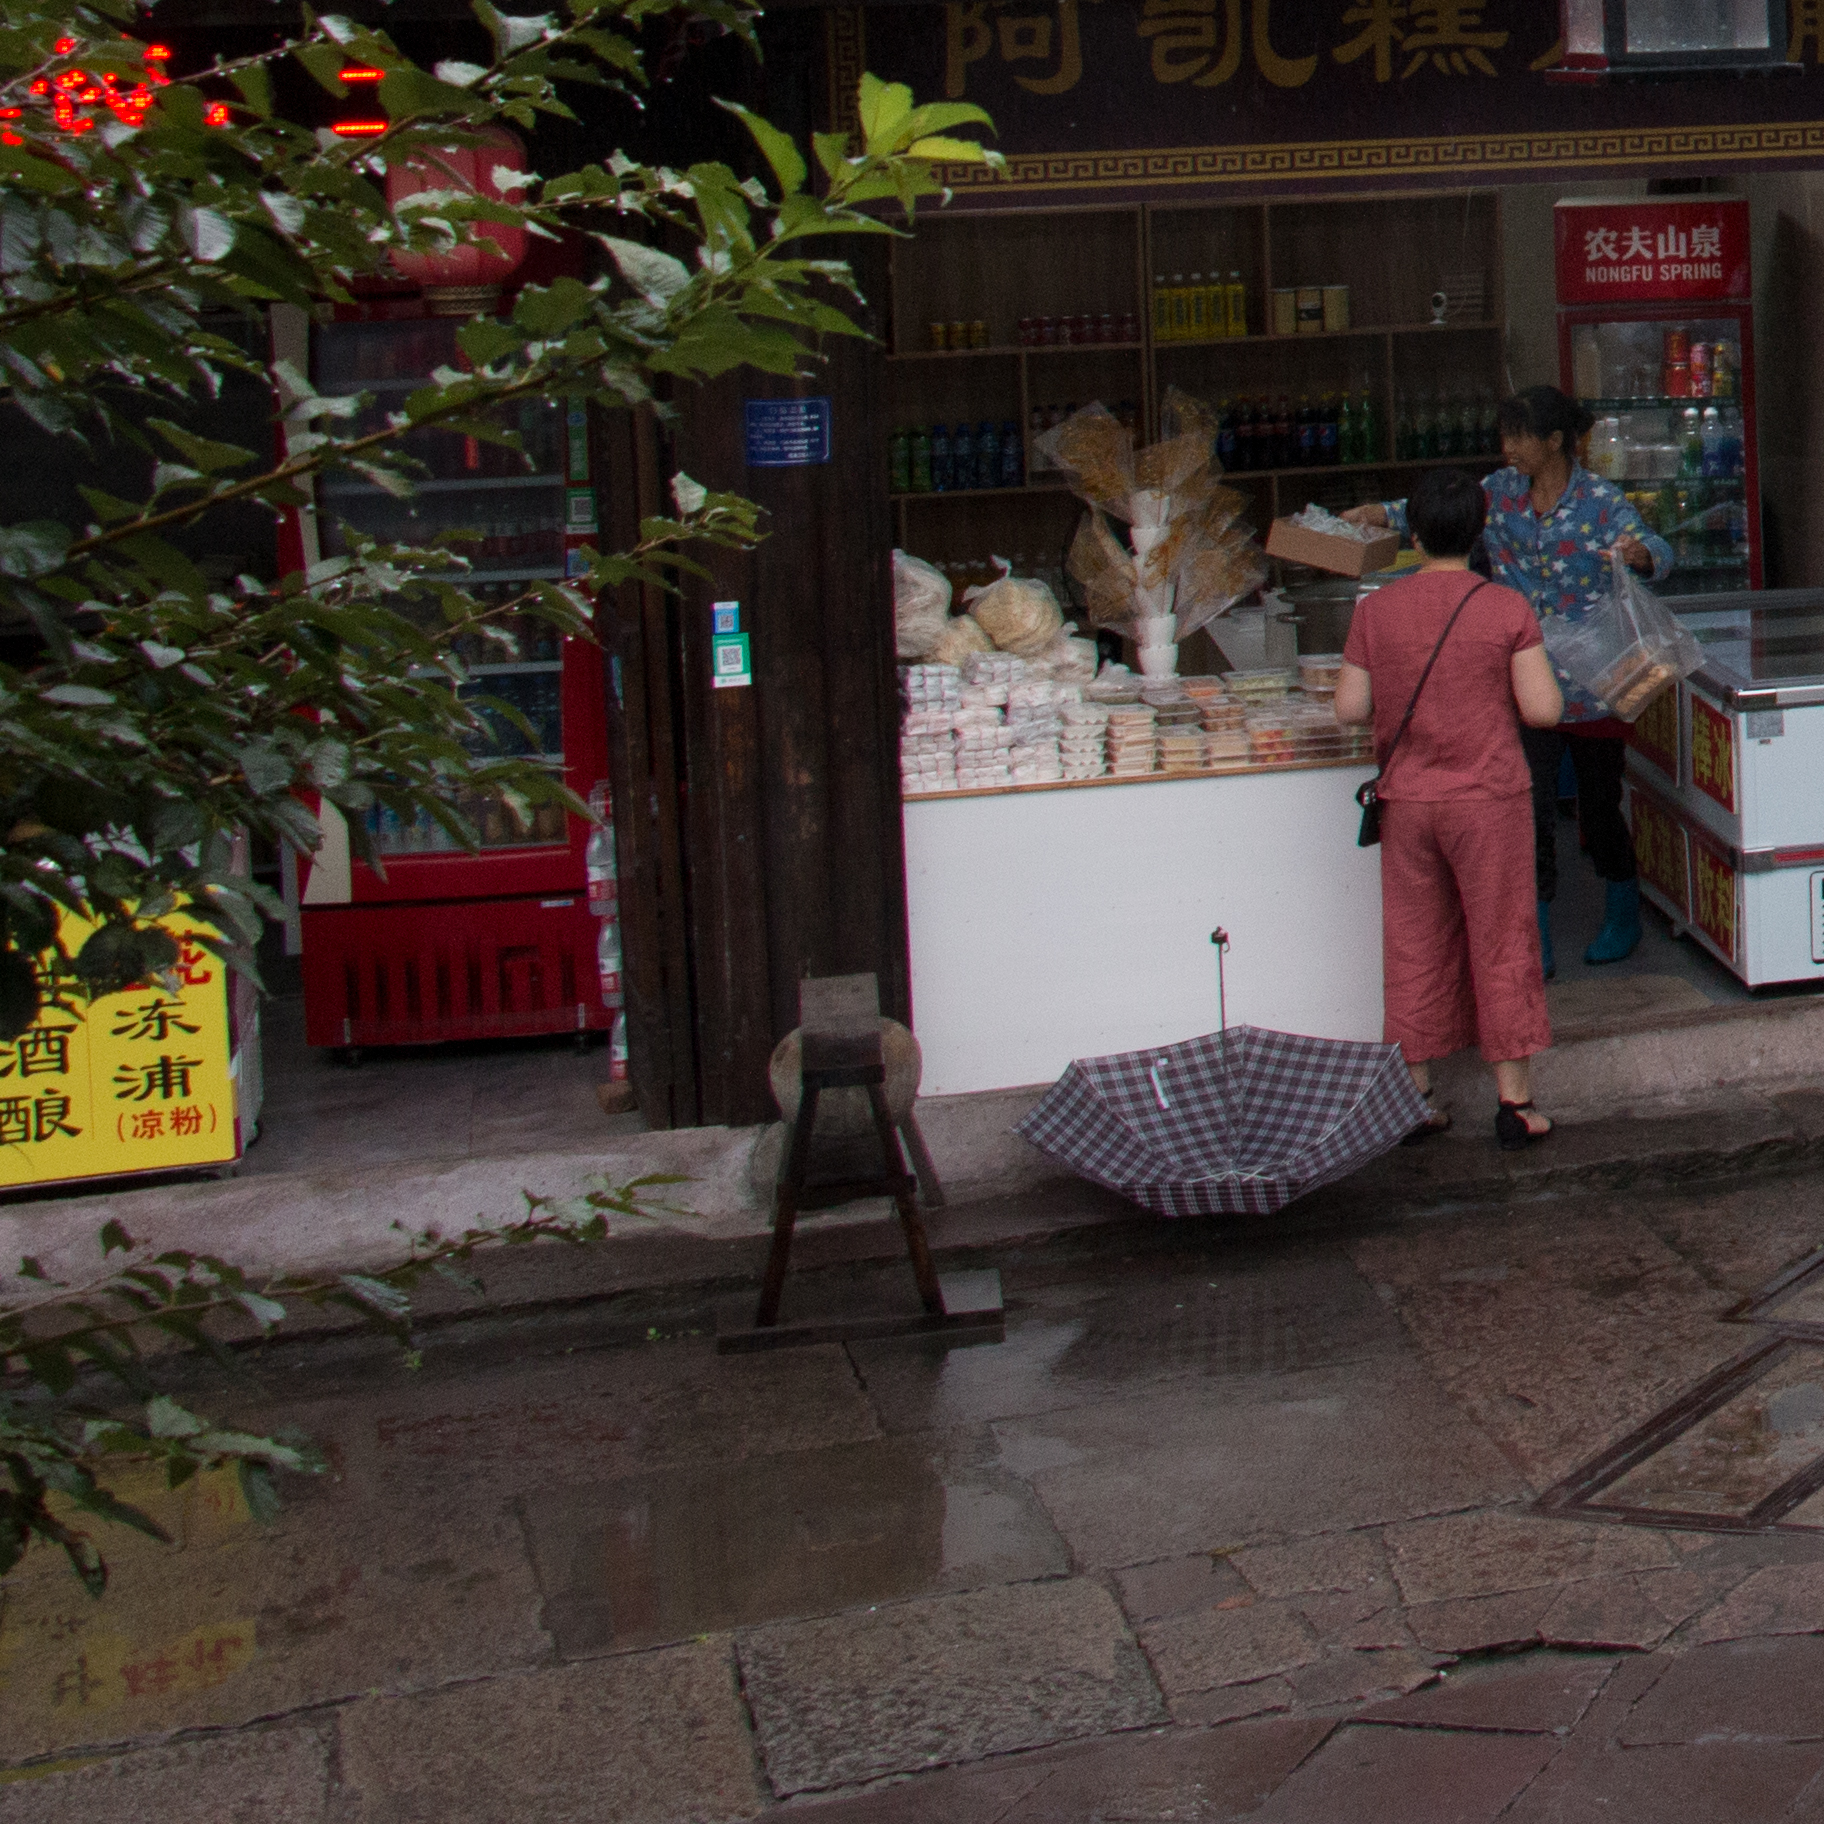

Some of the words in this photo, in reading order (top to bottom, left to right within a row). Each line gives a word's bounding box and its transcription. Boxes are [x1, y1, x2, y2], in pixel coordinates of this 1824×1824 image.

[1584, 224, 1722, 261] 农夫山泉
[1585, 265, 1653, 283] NONGFU
[1660, 262, 1722, 281] SPRING
[111, 998, 204, 1102] 冻浦
[117, 1102, 217, 1143] (凉粉)
